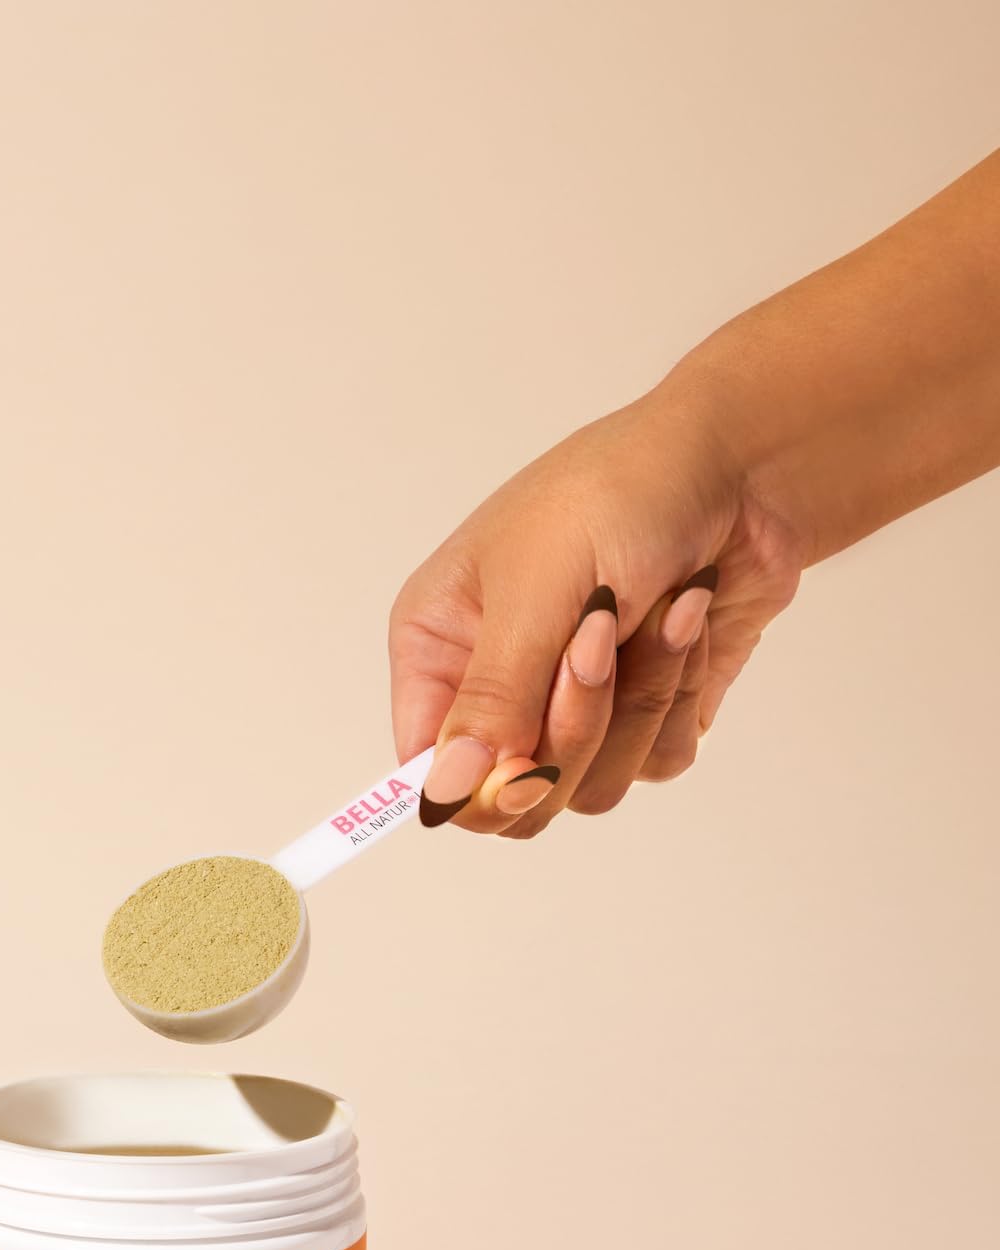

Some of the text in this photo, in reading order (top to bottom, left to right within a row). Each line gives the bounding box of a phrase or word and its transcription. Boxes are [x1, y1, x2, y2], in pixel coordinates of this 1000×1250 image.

[330, 778, 412, 835] BELLA
[350, 791, 421, 846] ALL NATUR
